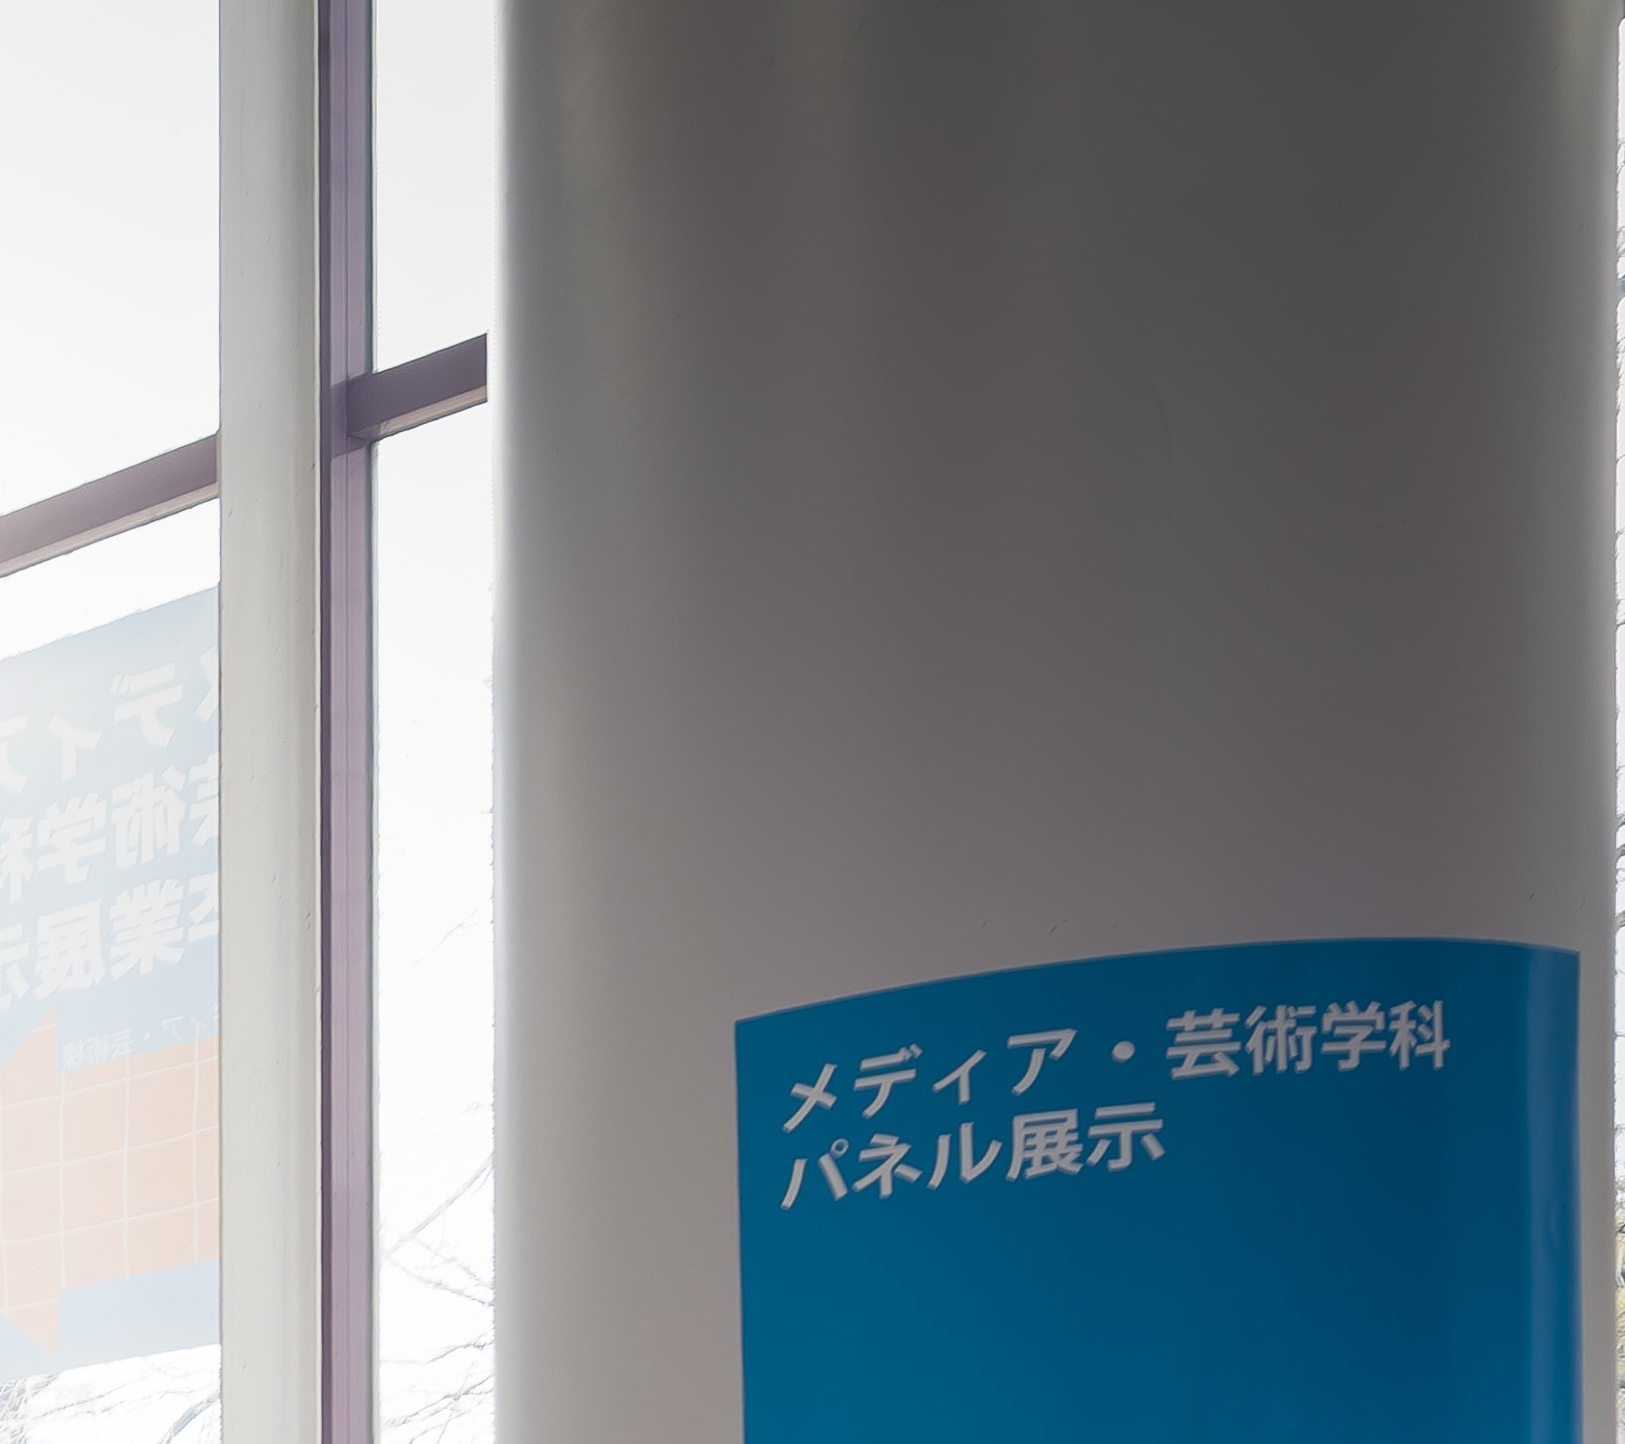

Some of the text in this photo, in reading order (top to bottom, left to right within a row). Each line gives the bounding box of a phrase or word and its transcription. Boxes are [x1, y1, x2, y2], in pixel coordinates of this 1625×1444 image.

[781, 1000, 1451, 1134] メディア・芸術学科
[780, 1101, 1166, 1211] パネル展示
